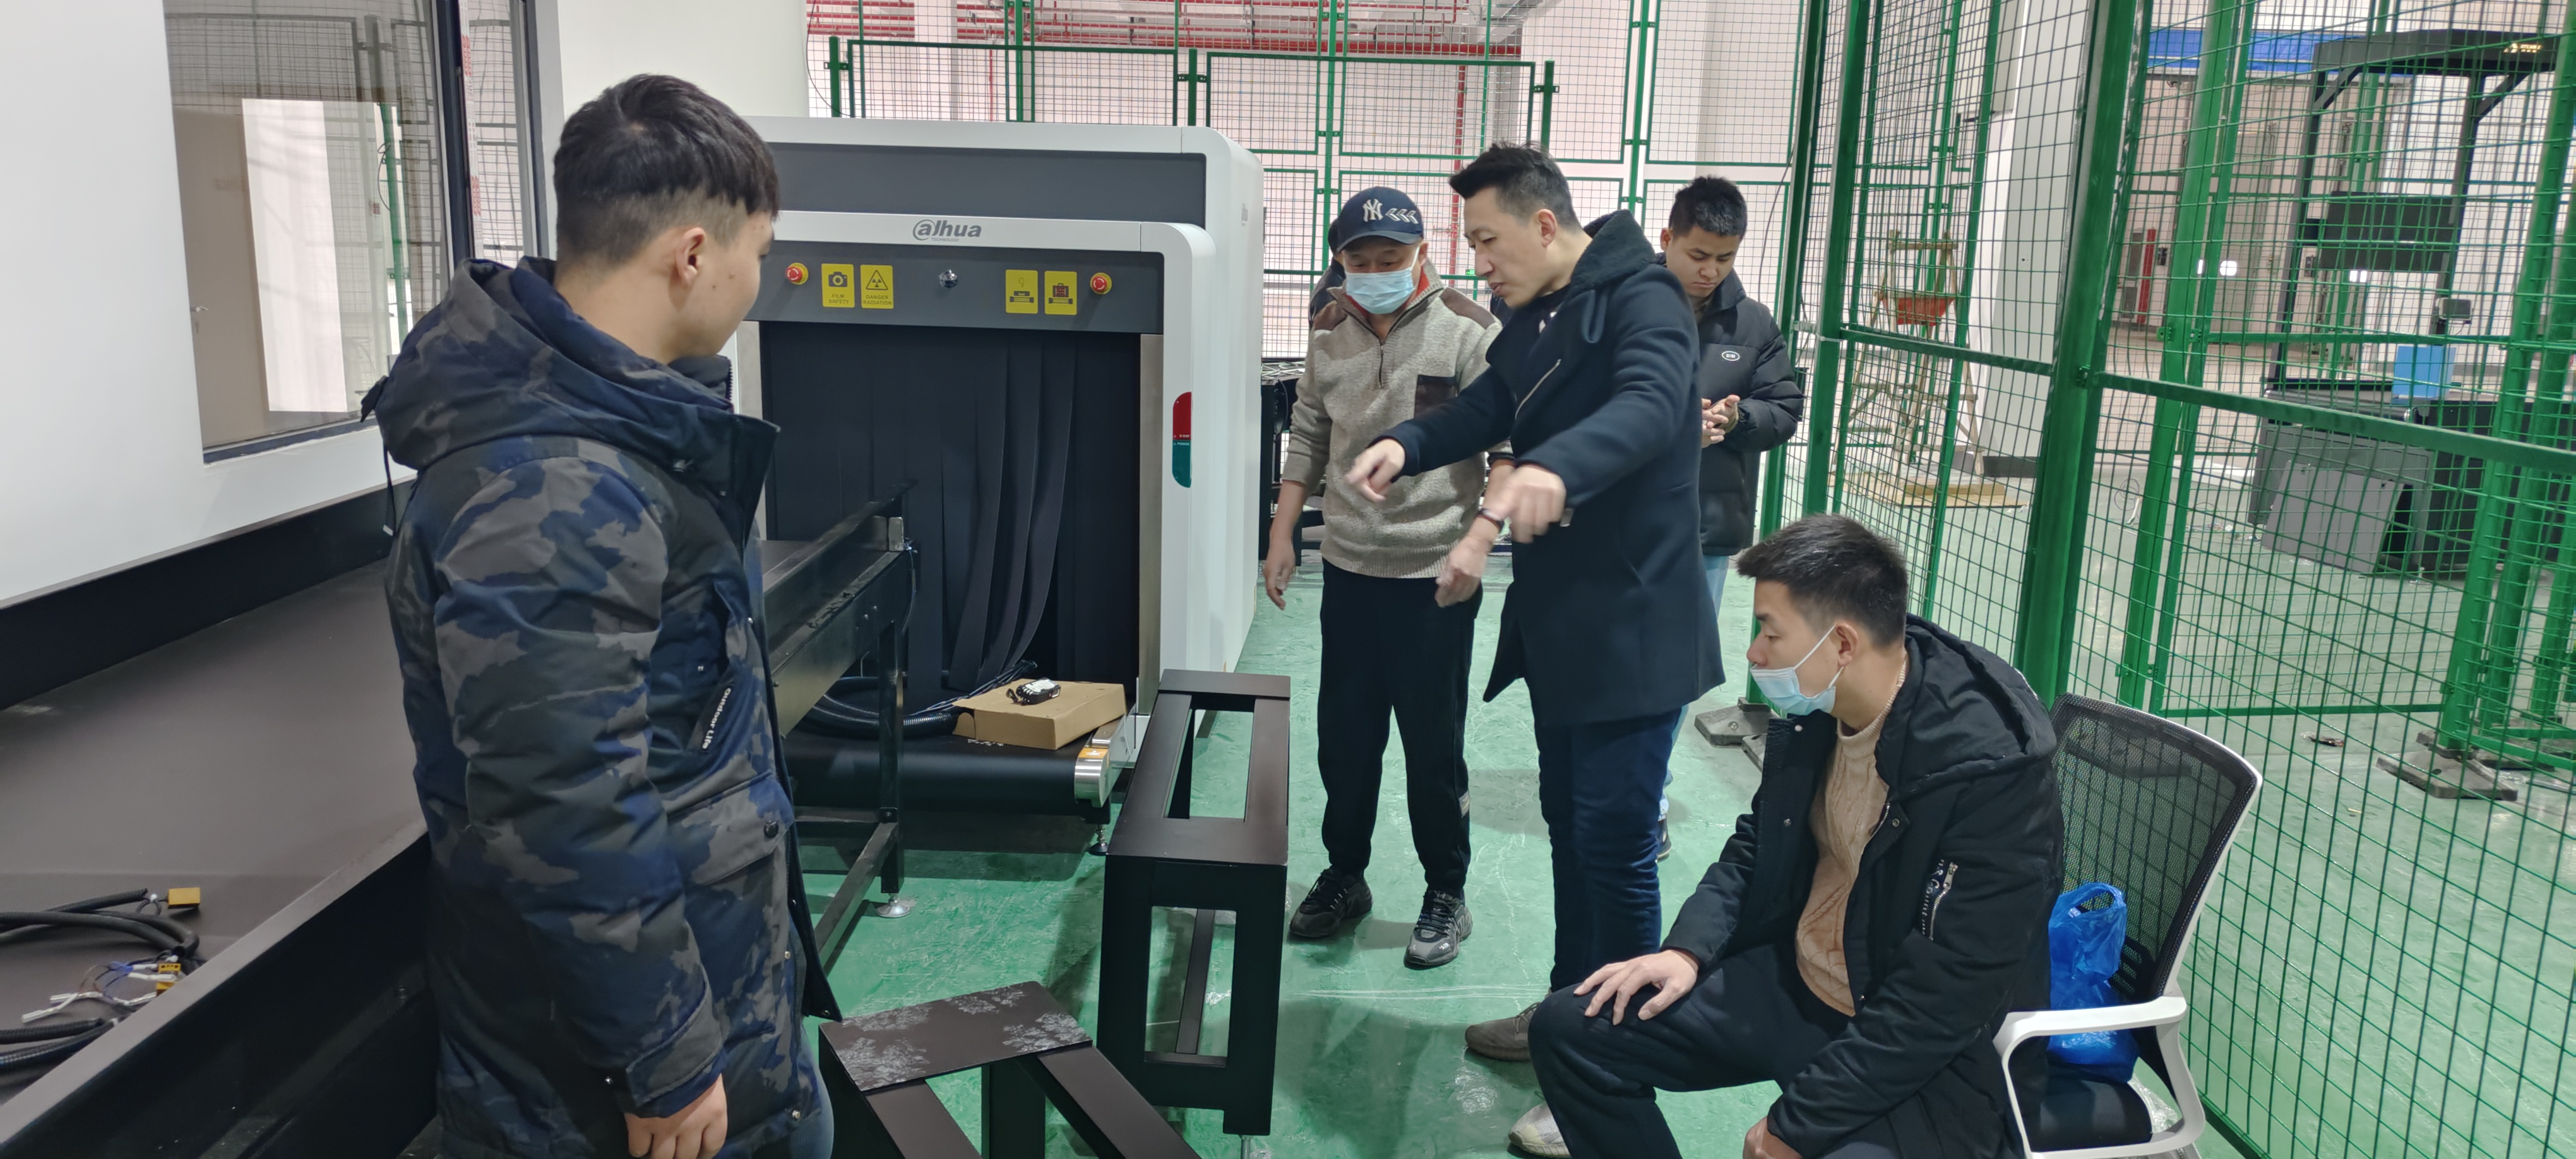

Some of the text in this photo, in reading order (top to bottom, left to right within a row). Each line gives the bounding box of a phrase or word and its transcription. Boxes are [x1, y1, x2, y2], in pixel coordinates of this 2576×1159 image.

[1363, 199, 1383, 222] NY
[702, 688, 731, 749] Outdoor Life
